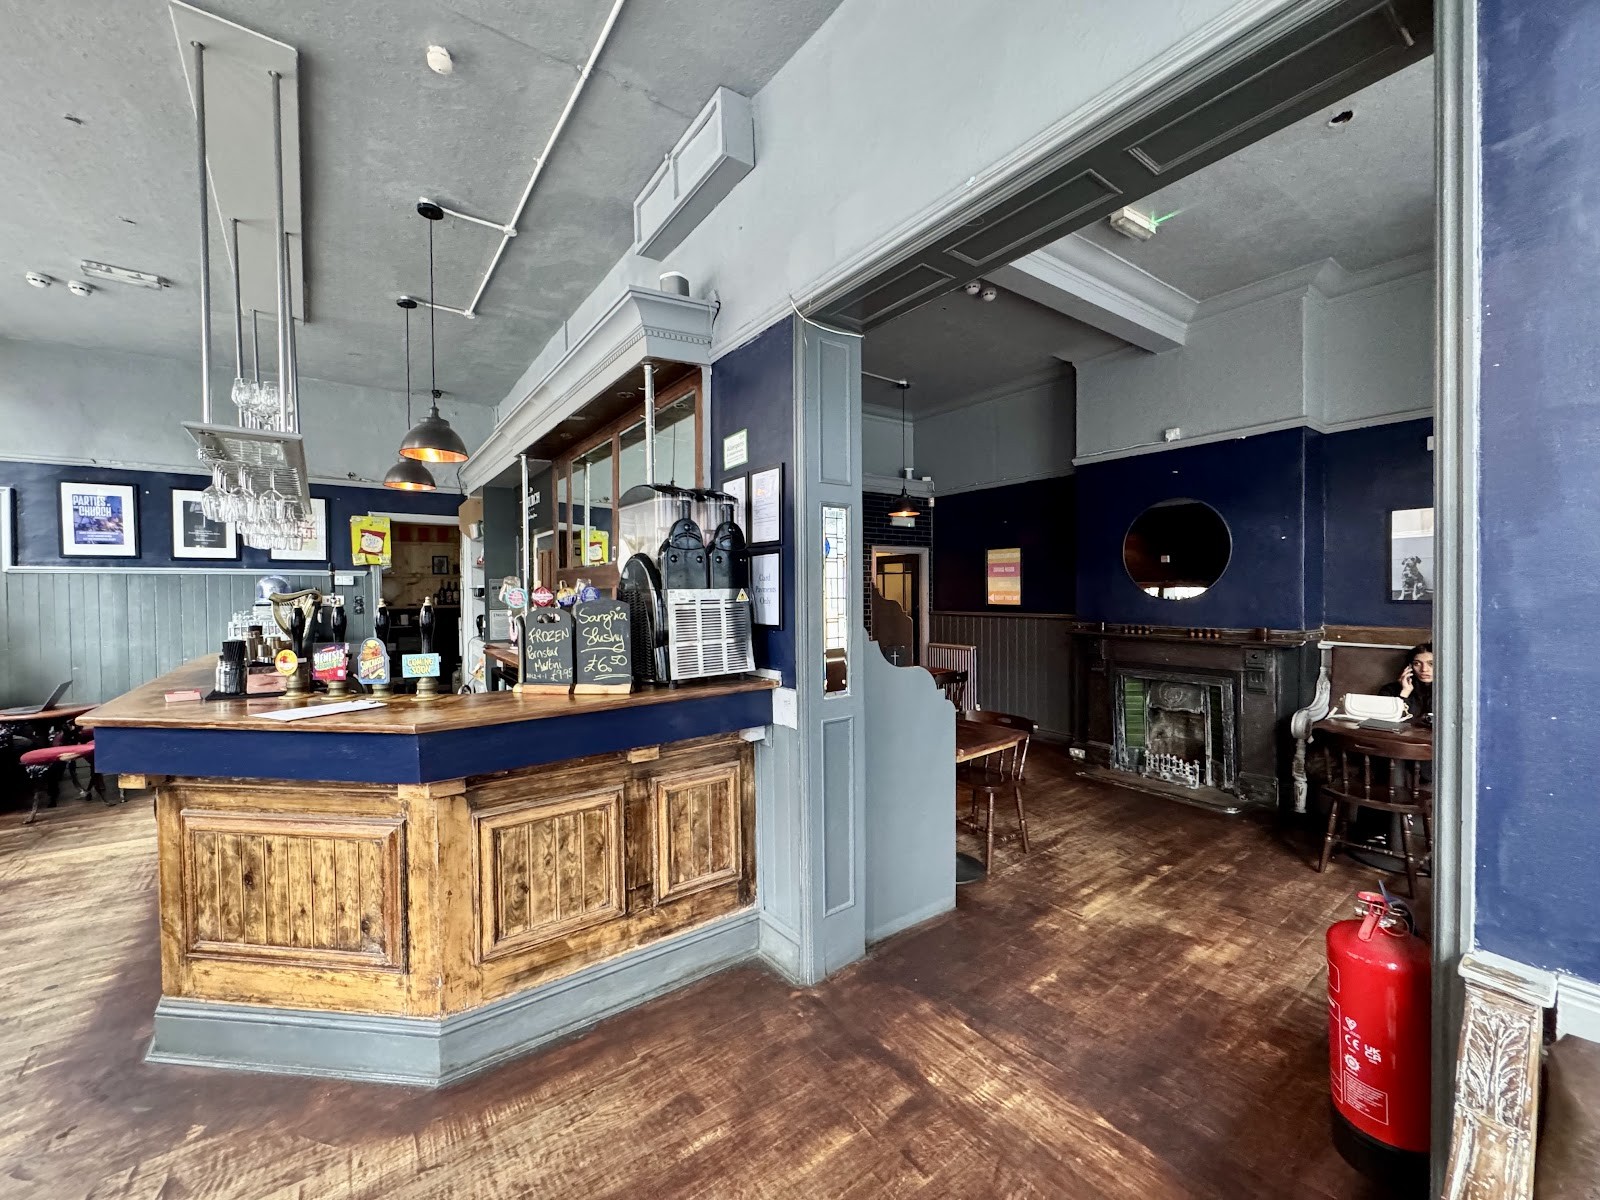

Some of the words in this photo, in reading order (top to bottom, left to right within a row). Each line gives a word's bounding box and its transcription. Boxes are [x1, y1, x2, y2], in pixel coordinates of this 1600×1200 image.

[73, 495, 106, 507] PARTIES
[79, 505, 112, 517] CHURCH
[758, 573, 771, 582] Card
[755, 586, 777, 595] Payments
[759, 596, 772, 606] Only
[578, 606, 628, 630] Sangria
[528, 627, 570, 644] FROZEN
[582, 626, 625, 652] Slushy
[407, 657, 434, 667] COMING
[411, 665, 431, 675] SOON
